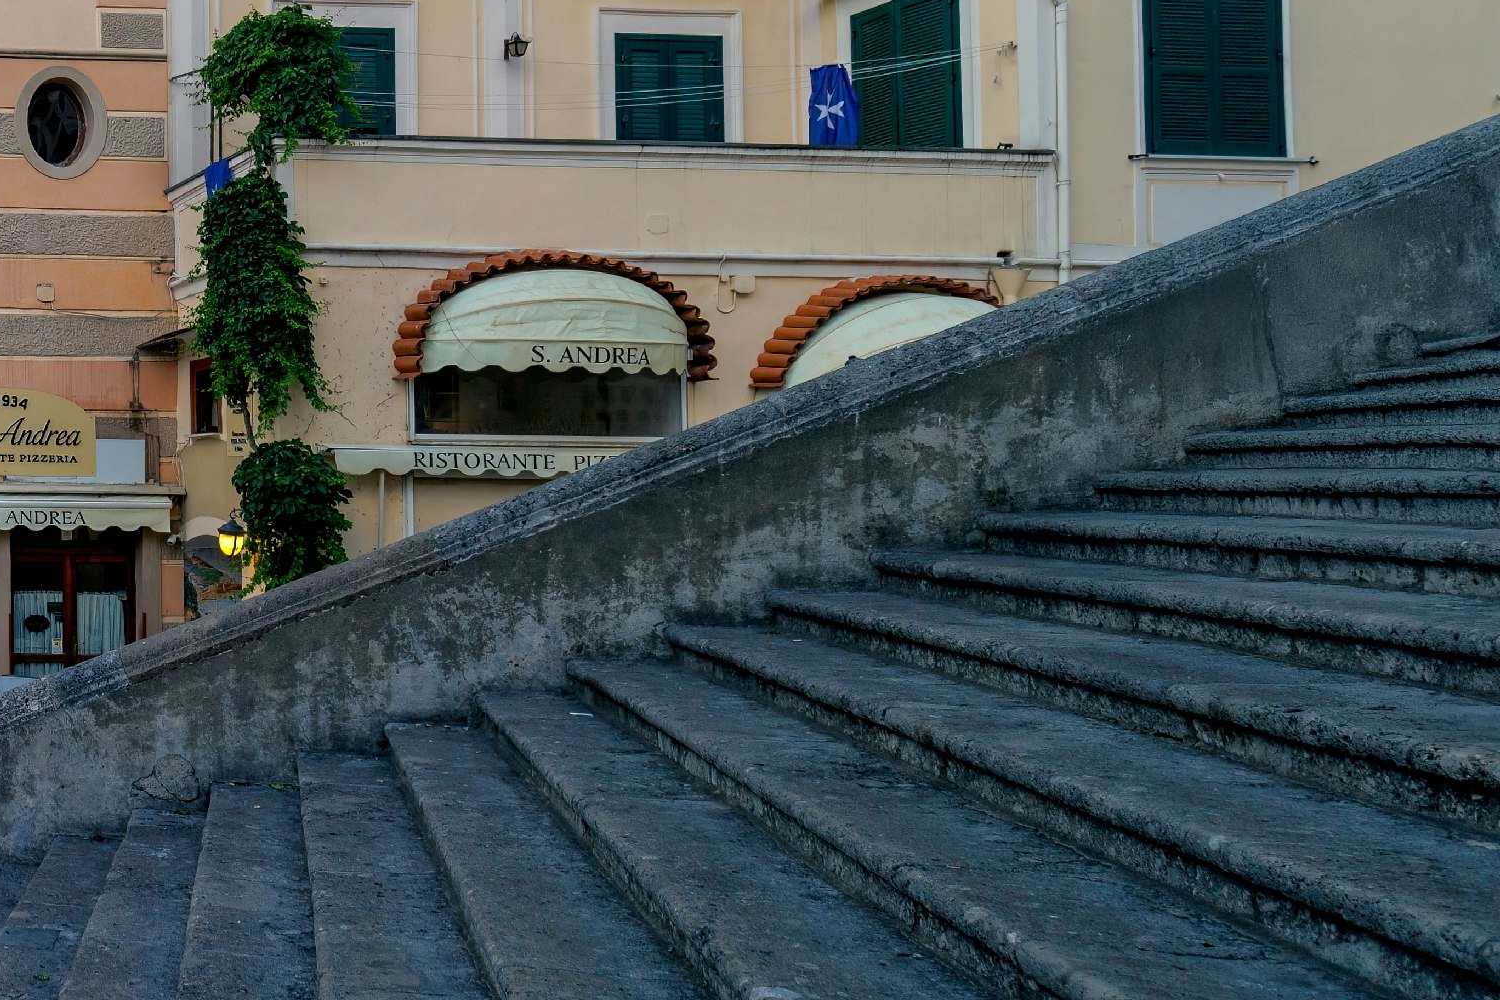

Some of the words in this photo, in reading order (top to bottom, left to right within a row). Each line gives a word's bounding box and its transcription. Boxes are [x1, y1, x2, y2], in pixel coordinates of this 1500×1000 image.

[531, 344, 551, 363] S.
[558, 345, 651, 365] ANDREA
[19, 454, 78, 464] PIZZERIA
[413, 450, 556, 471] RISTORANTE
[573, 454, 618, 471] PIZ
[5, 509, 86, 525] ANDREA
